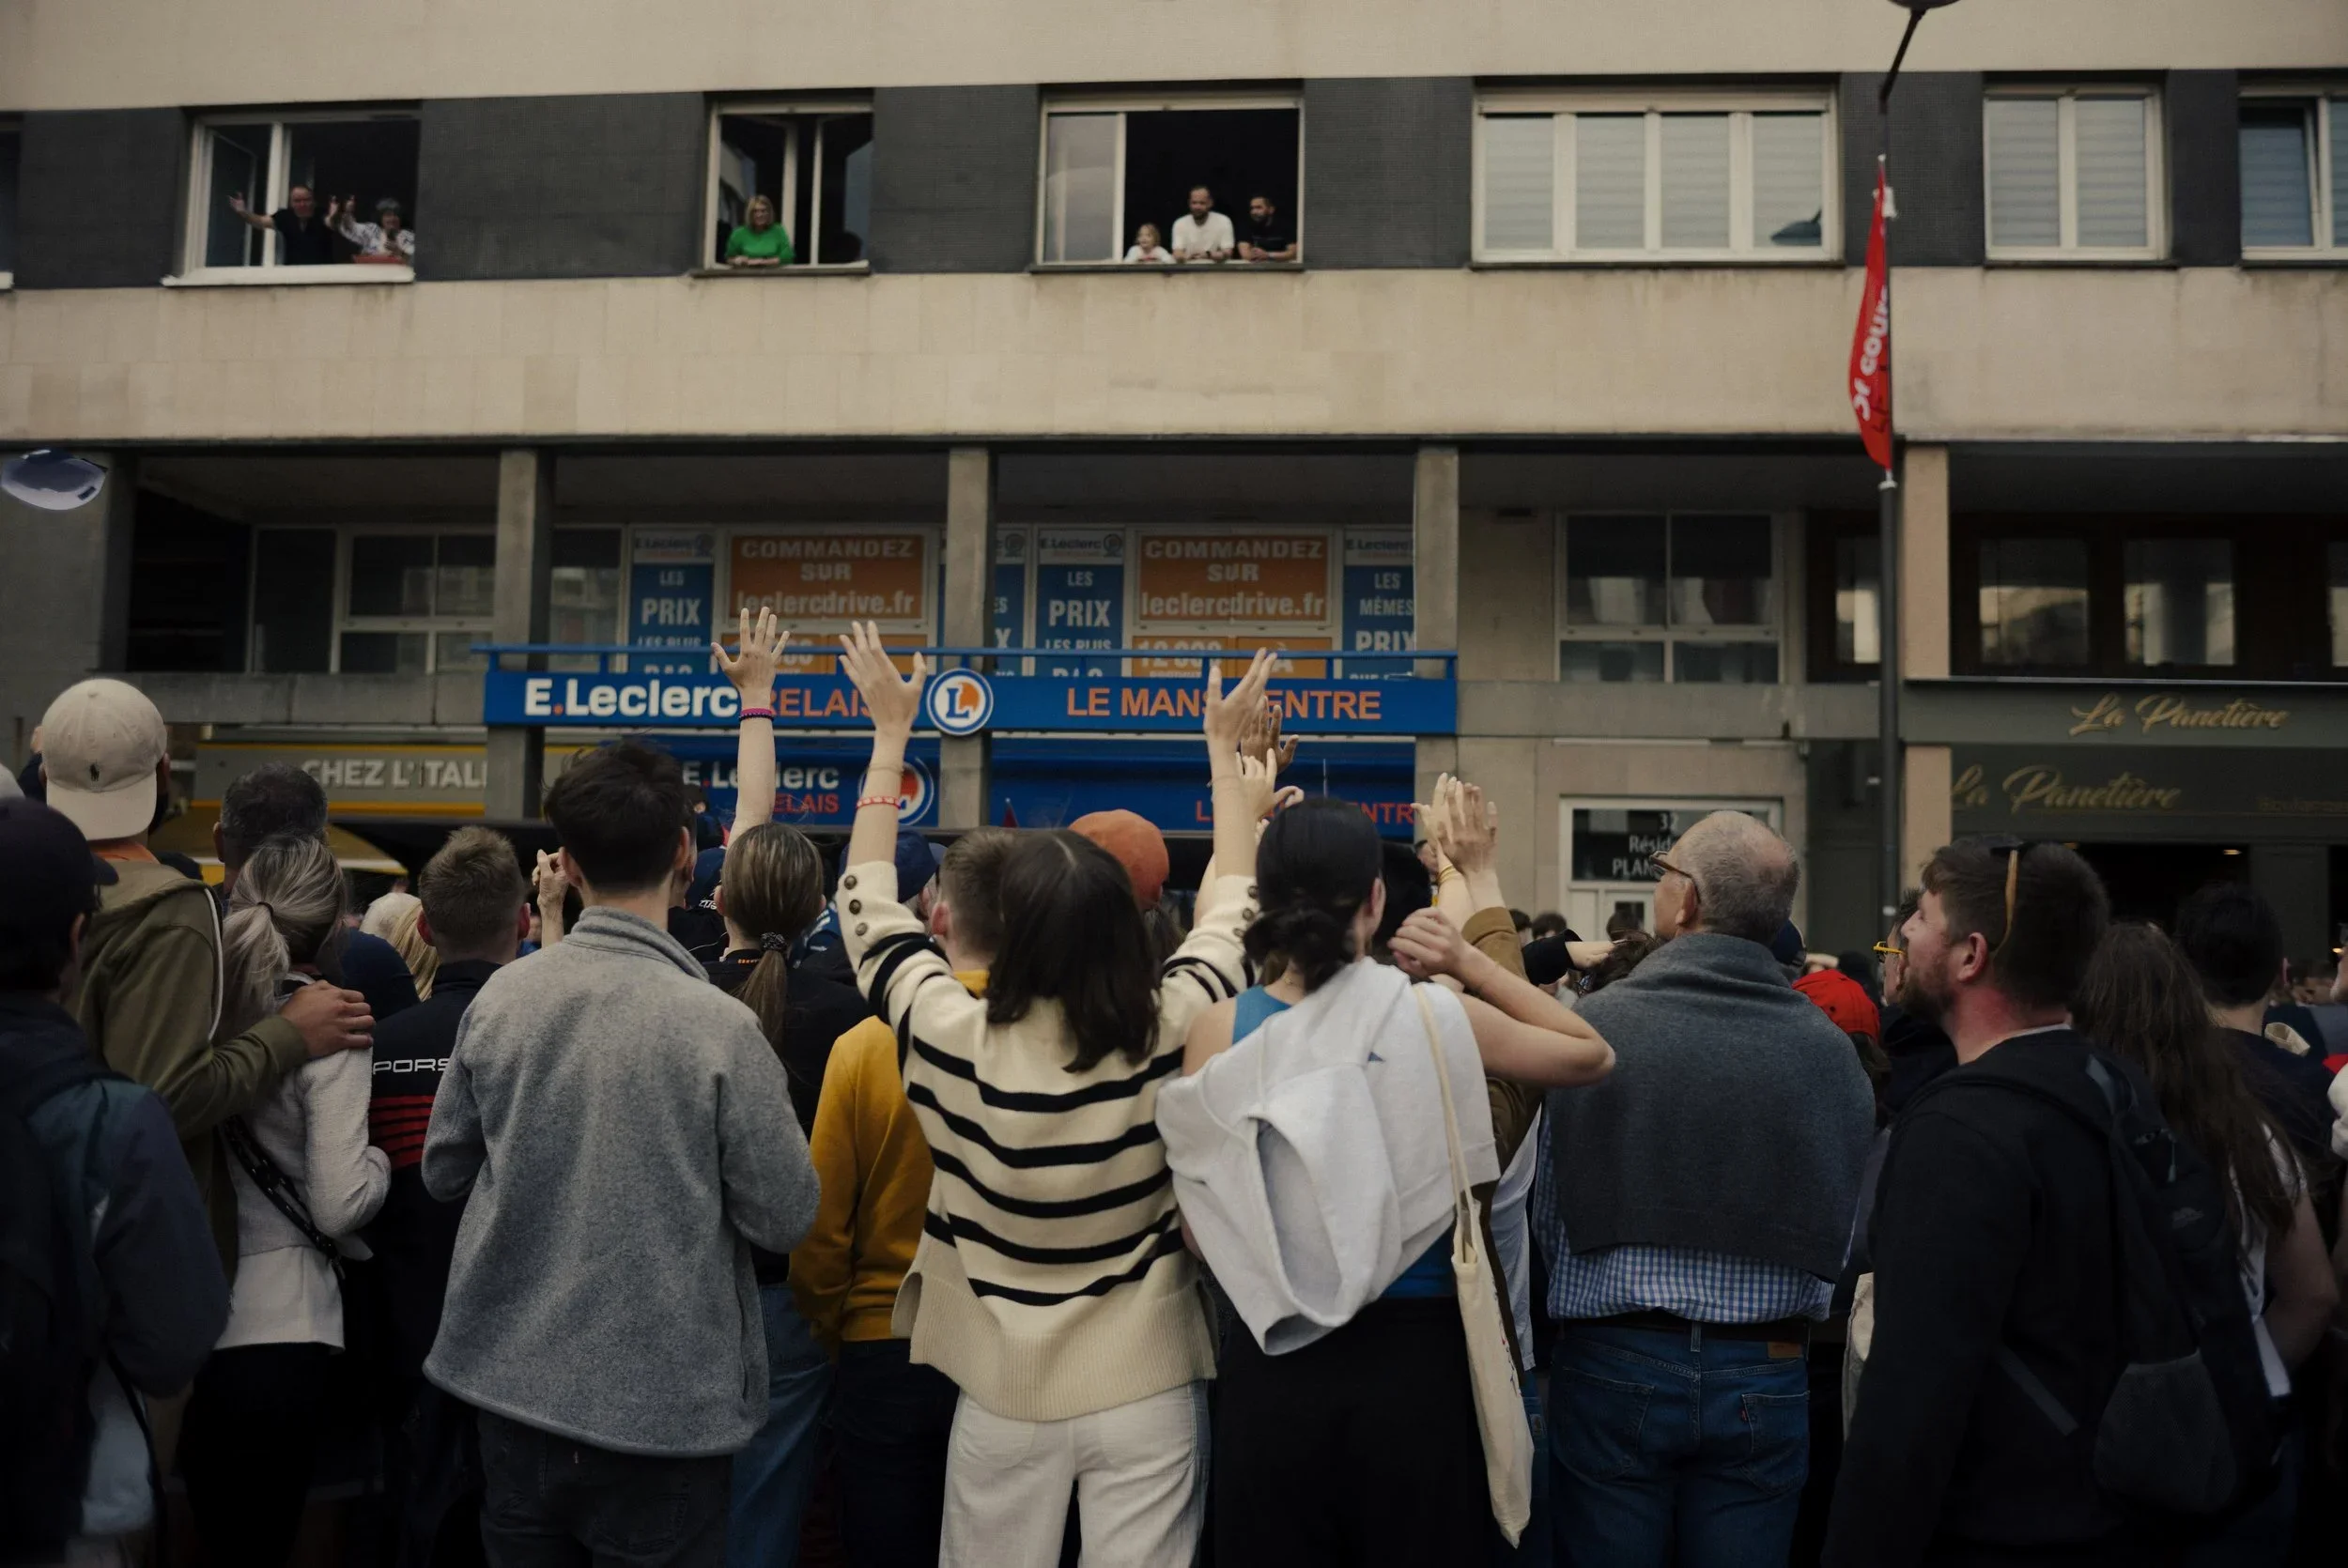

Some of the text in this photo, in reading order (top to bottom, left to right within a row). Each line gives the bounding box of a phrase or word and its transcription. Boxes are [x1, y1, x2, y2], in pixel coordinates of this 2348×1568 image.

[740, 540, 914, 559] COMMANDEZ
[1144, 540, 1323, 559] COMMANDEZ
[659, 571, 685, 587] LES
[800, 563, 852, 581] SUR
[1067, 571, 1094, 587] LES
[1207, 563, 1259, 582] SUR
[1374, 572, 1401, 590] LES
[641, 598, 702, 626] PRIX
[736, 591, 915, 616] leclercdrive.fr
[1048, 599, 1112, 627] PRIX
[1141, 591, 1324, 616] leclercdrive.fr
[525, 678, 739, 716] E.Leclerc
[1067, 688, 1110, 716] LE
[1267, 690, 1382, 719] ENTRE
[2069, 692, 2291, 736] La Panetière
[301, 759, 385, 787] CHEZ
[2001, 764, 2184, 815] Panetière
[773, 792, 839, 814] ELAIS
[1629, 834, 1675, 853] Résid
